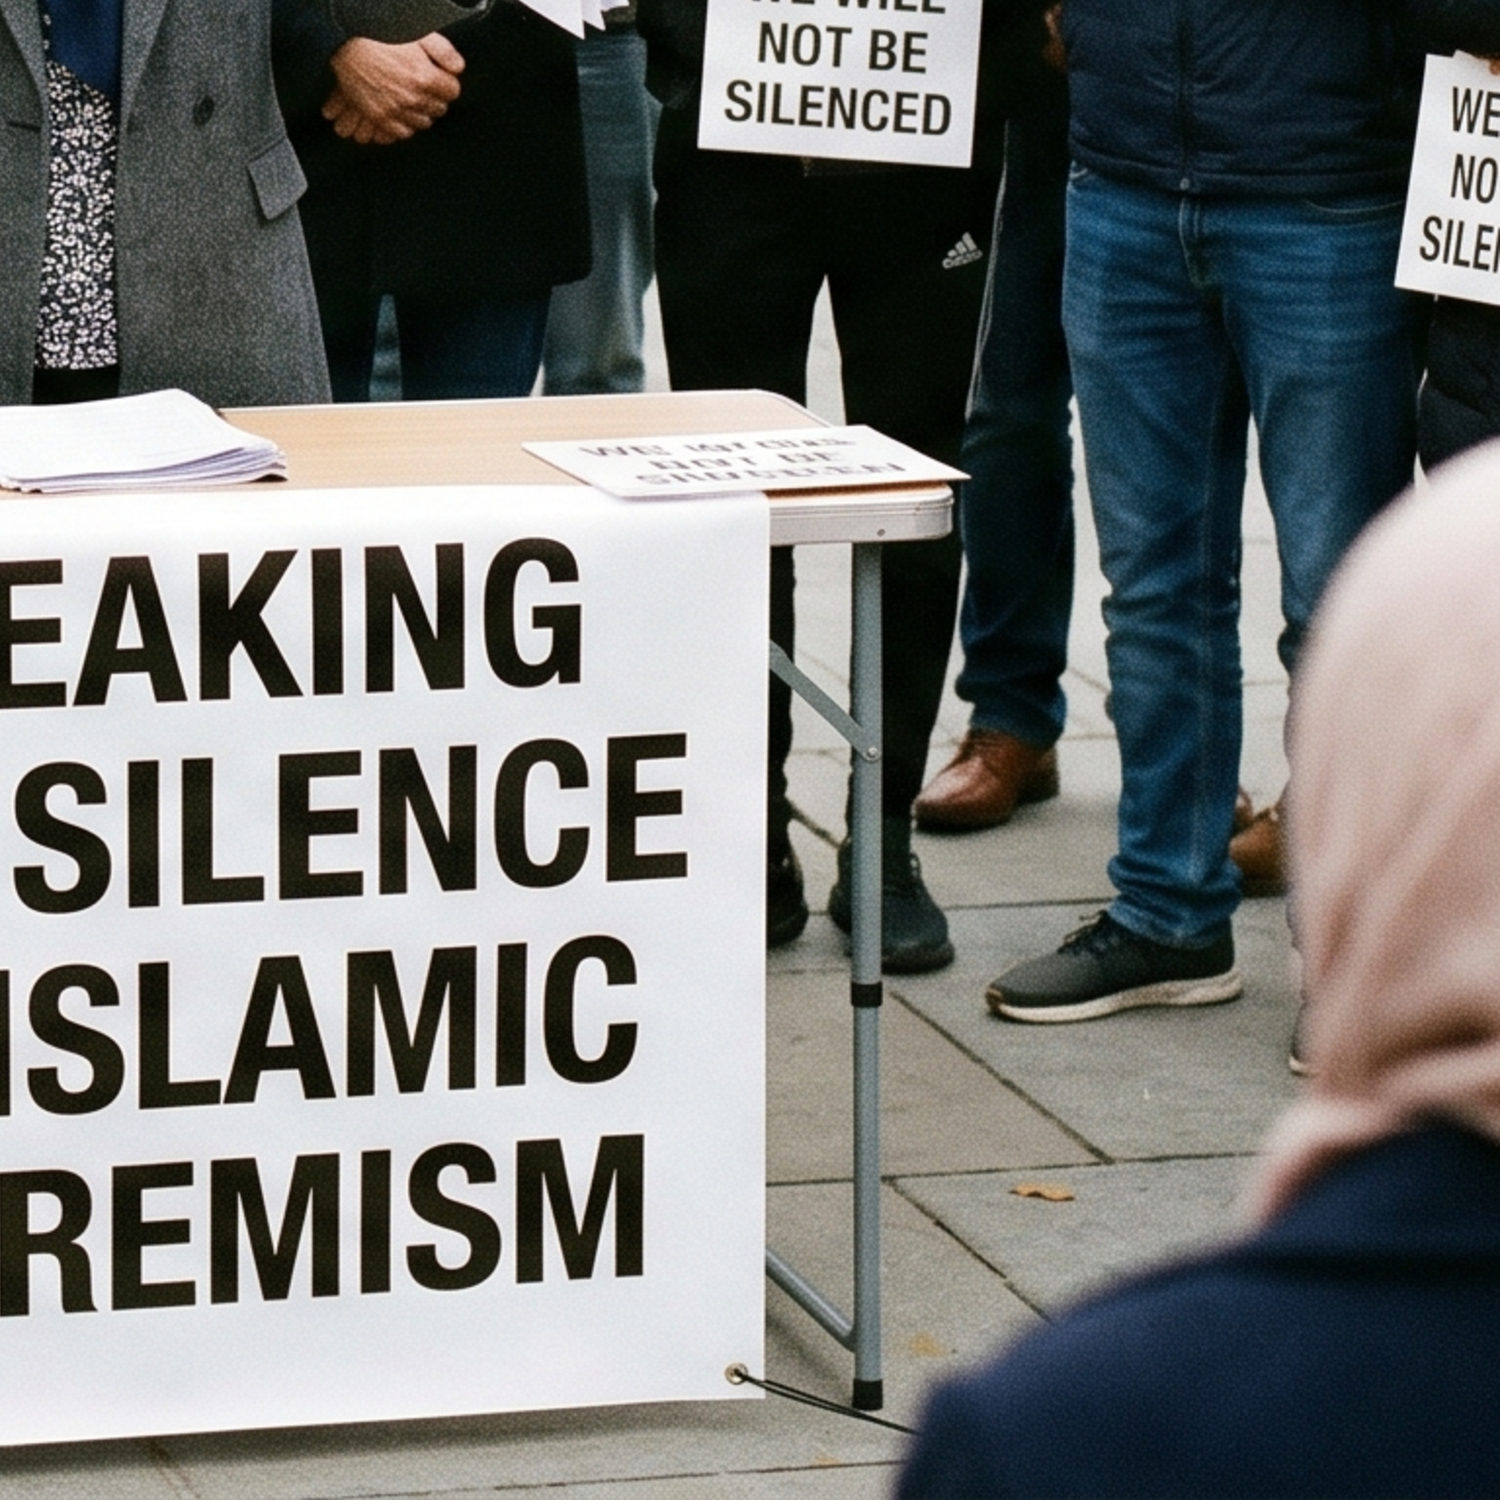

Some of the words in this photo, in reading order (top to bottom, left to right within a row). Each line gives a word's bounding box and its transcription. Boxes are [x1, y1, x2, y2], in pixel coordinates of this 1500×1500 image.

[758, 21, 853, 68] NOT
[868, 29, 928, 74] BE
[724, 79, 951, 136] SILENCED
[1452, 86, 1500, 138] WE
[13, 732, 688, 914] SILENCE
